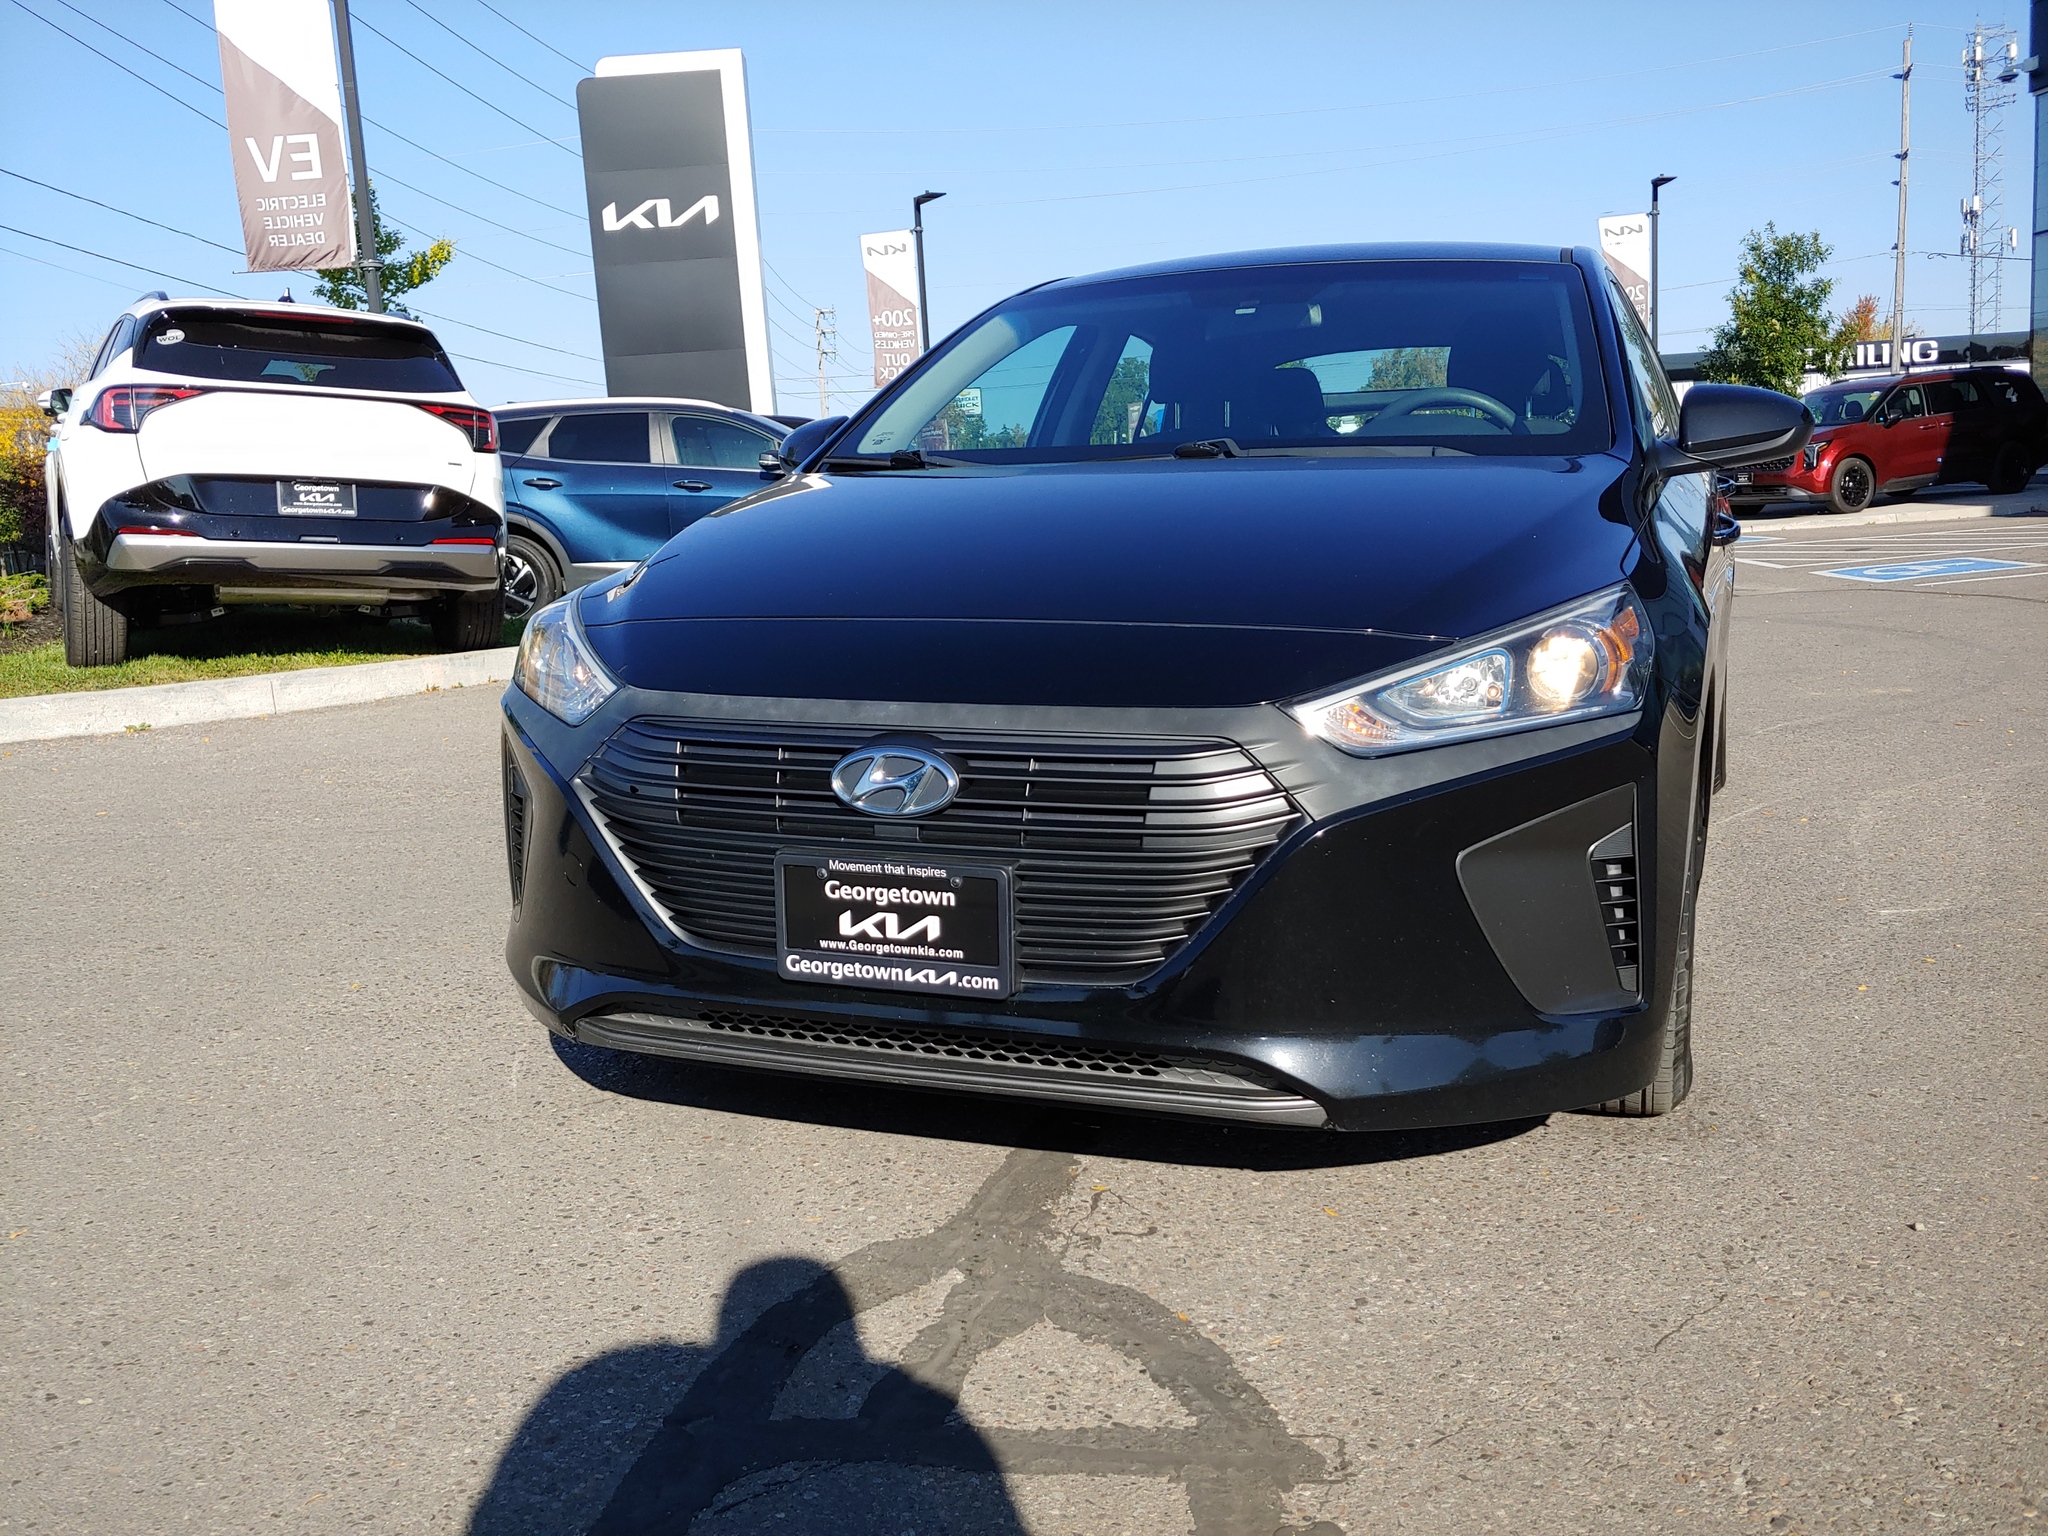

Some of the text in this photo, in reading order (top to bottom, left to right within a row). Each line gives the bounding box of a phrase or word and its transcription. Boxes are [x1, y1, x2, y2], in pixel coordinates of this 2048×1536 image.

[602, 195, 720, 231] KIA
[294, 484, 340, 492] Georgetown
[299, 492, 335, 502] KIA
[828, 859, 947, 878] Movement that inspires
[824, 880, 956, 906] Georgetown
[838, 909, 940, 942] KIA
[819, 939, 964, 959] www.Georgetownkia.com
